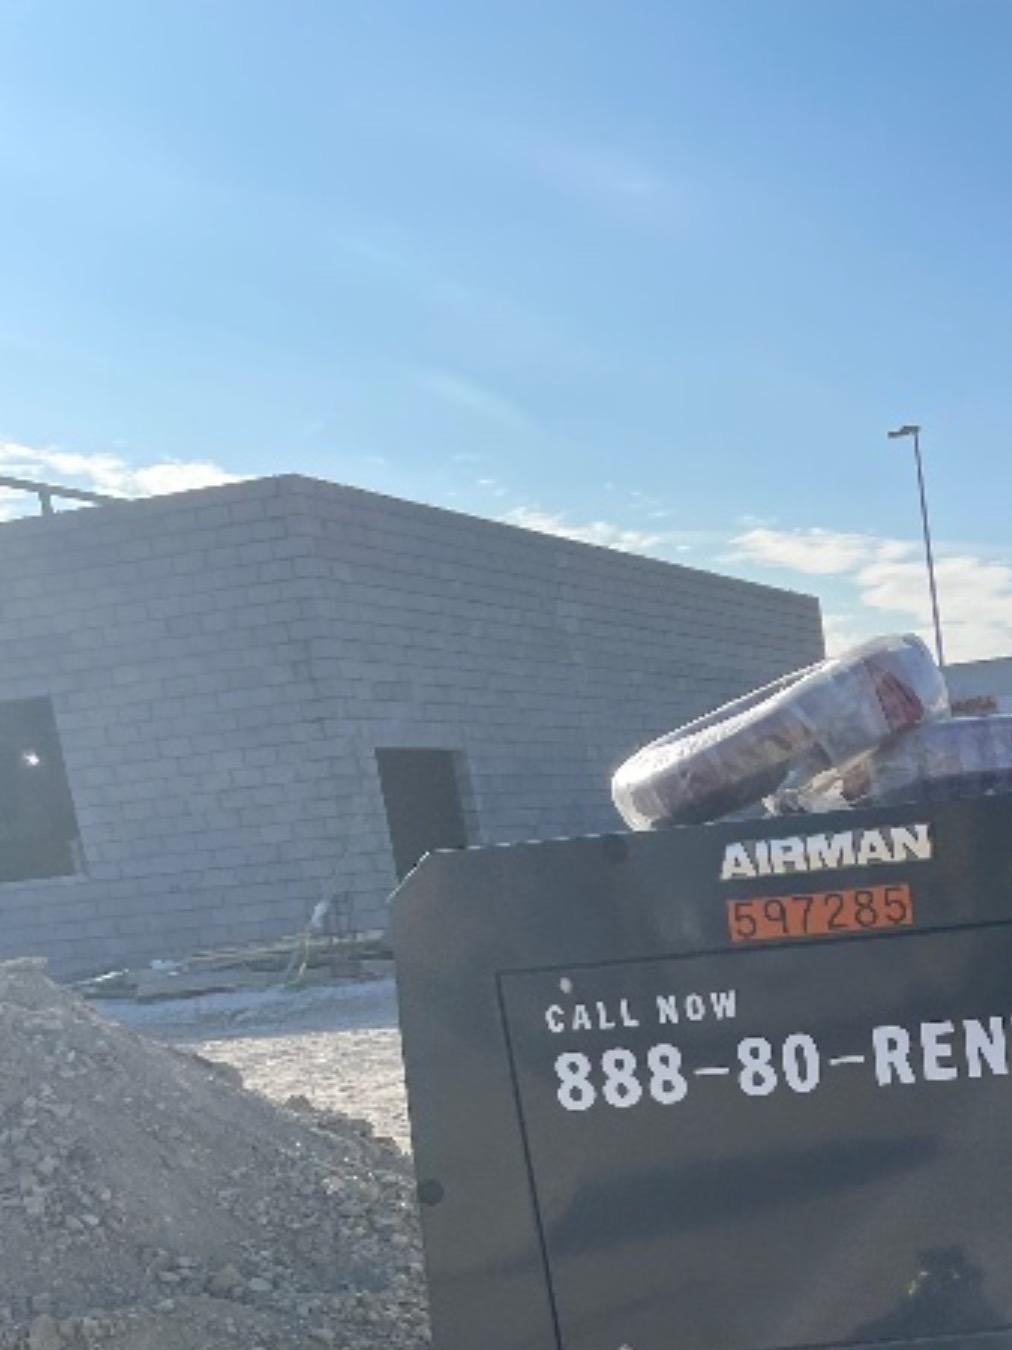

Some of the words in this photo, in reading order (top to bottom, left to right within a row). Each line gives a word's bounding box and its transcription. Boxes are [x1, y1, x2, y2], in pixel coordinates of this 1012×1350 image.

[720, 823, 932, 881] AIRMAN
[733, 887, 908, 938] 597285
[545, 999, 640, 1034] CALL
[656, 989, 738, 1026] NOW
